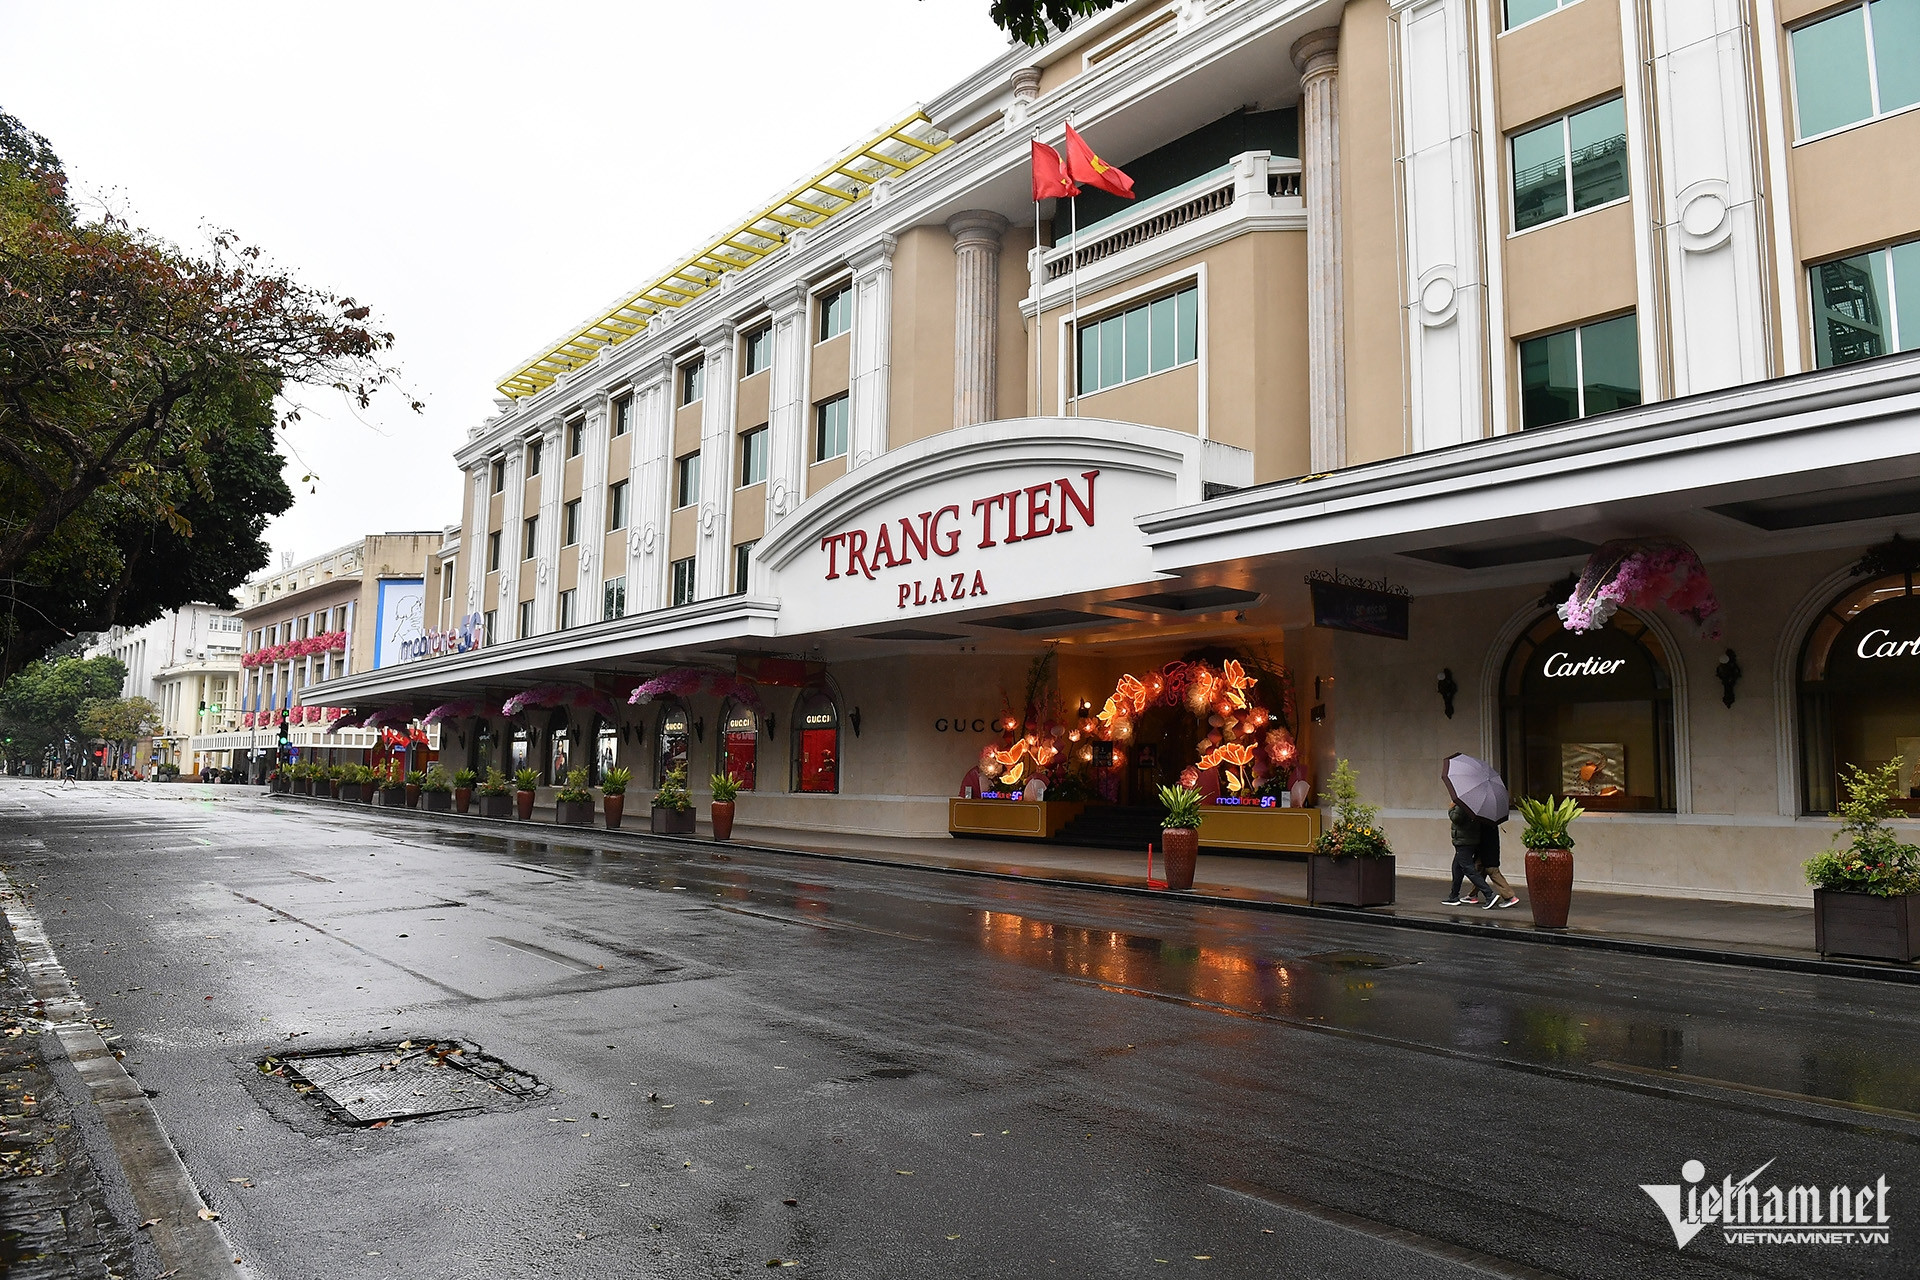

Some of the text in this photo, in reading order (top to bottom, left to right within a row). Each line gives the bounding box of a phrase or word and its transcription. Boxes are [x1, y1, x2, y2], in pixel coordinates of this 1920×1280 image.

[821, 469, 1100, 581] TRANG TIEN
[896, 568, 989, 610] PLAZA
[1543, 651, 1626, 679] Cartier
[665, 722, 683, 731] GUCCI
[729, 718, 750, 728] GUCCI
[806, 715, 830, 725] GUCCI
[935, 718, 1004, 733] GUCC
